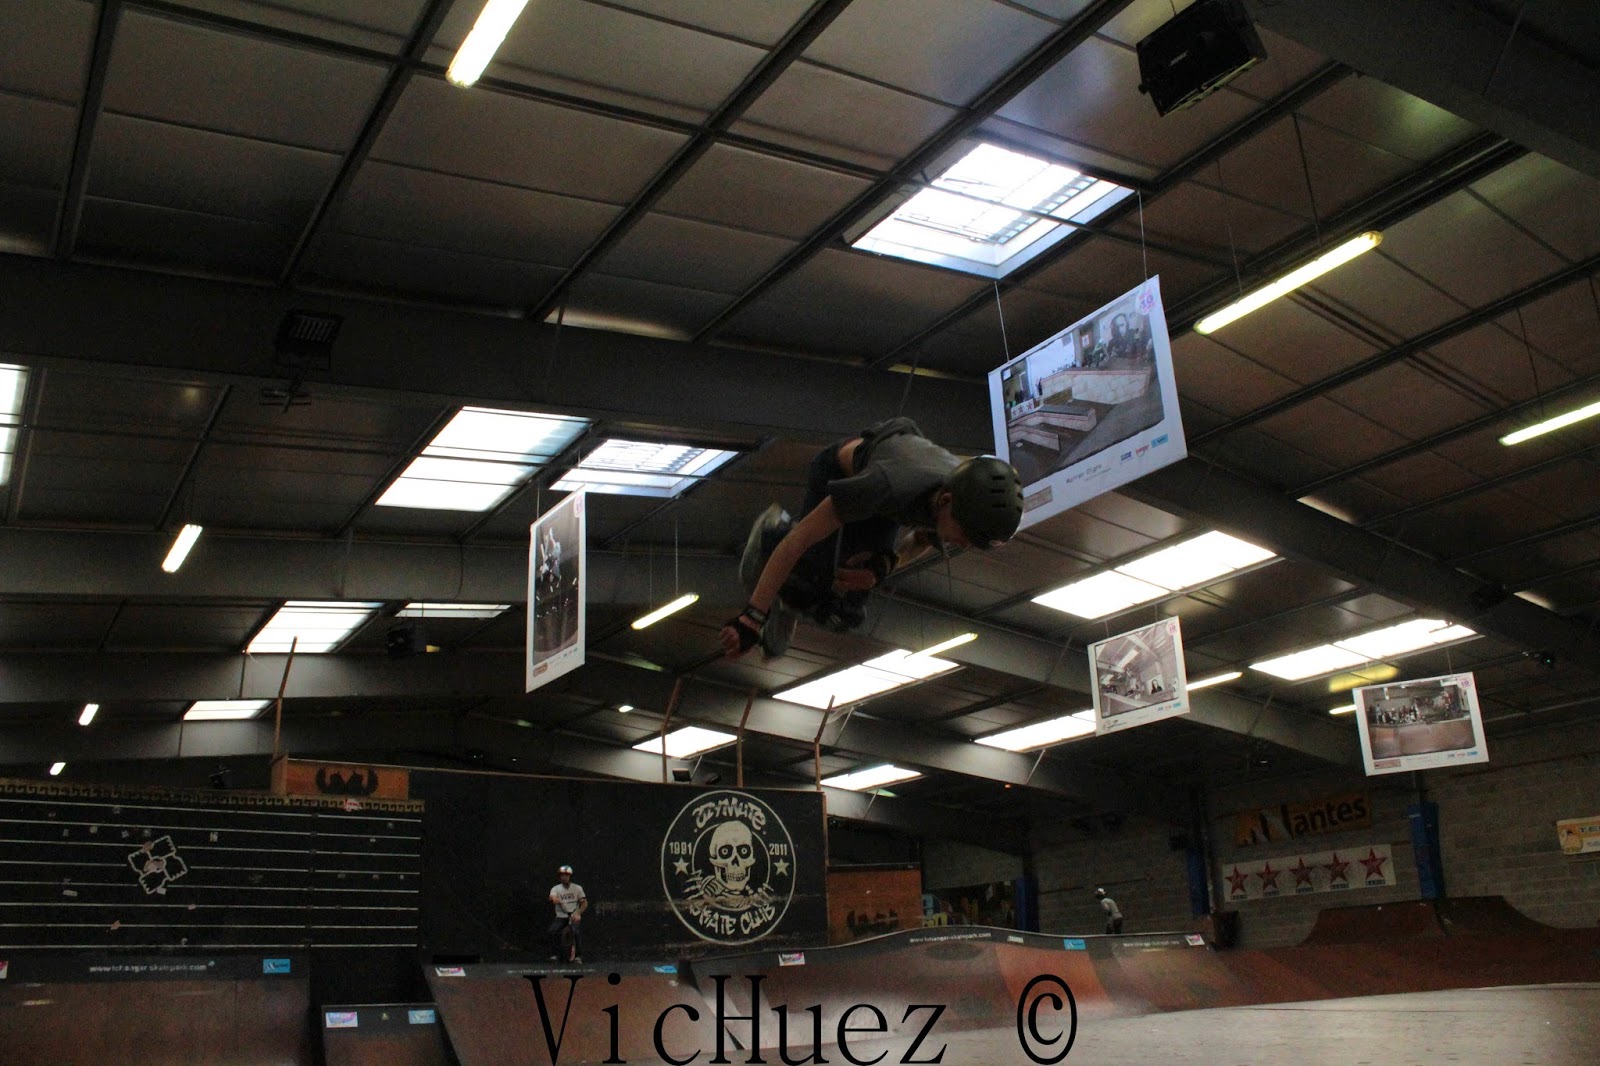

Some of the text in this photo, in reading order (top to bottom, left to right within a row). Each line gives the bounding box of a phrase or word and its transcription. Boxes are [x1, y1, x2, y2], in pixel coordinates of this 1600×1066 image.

[669, 841, 693, 856] 1991
[769, 843, 788, 856] 2011
[687, 903, 776, 936] SKATE CLUB
